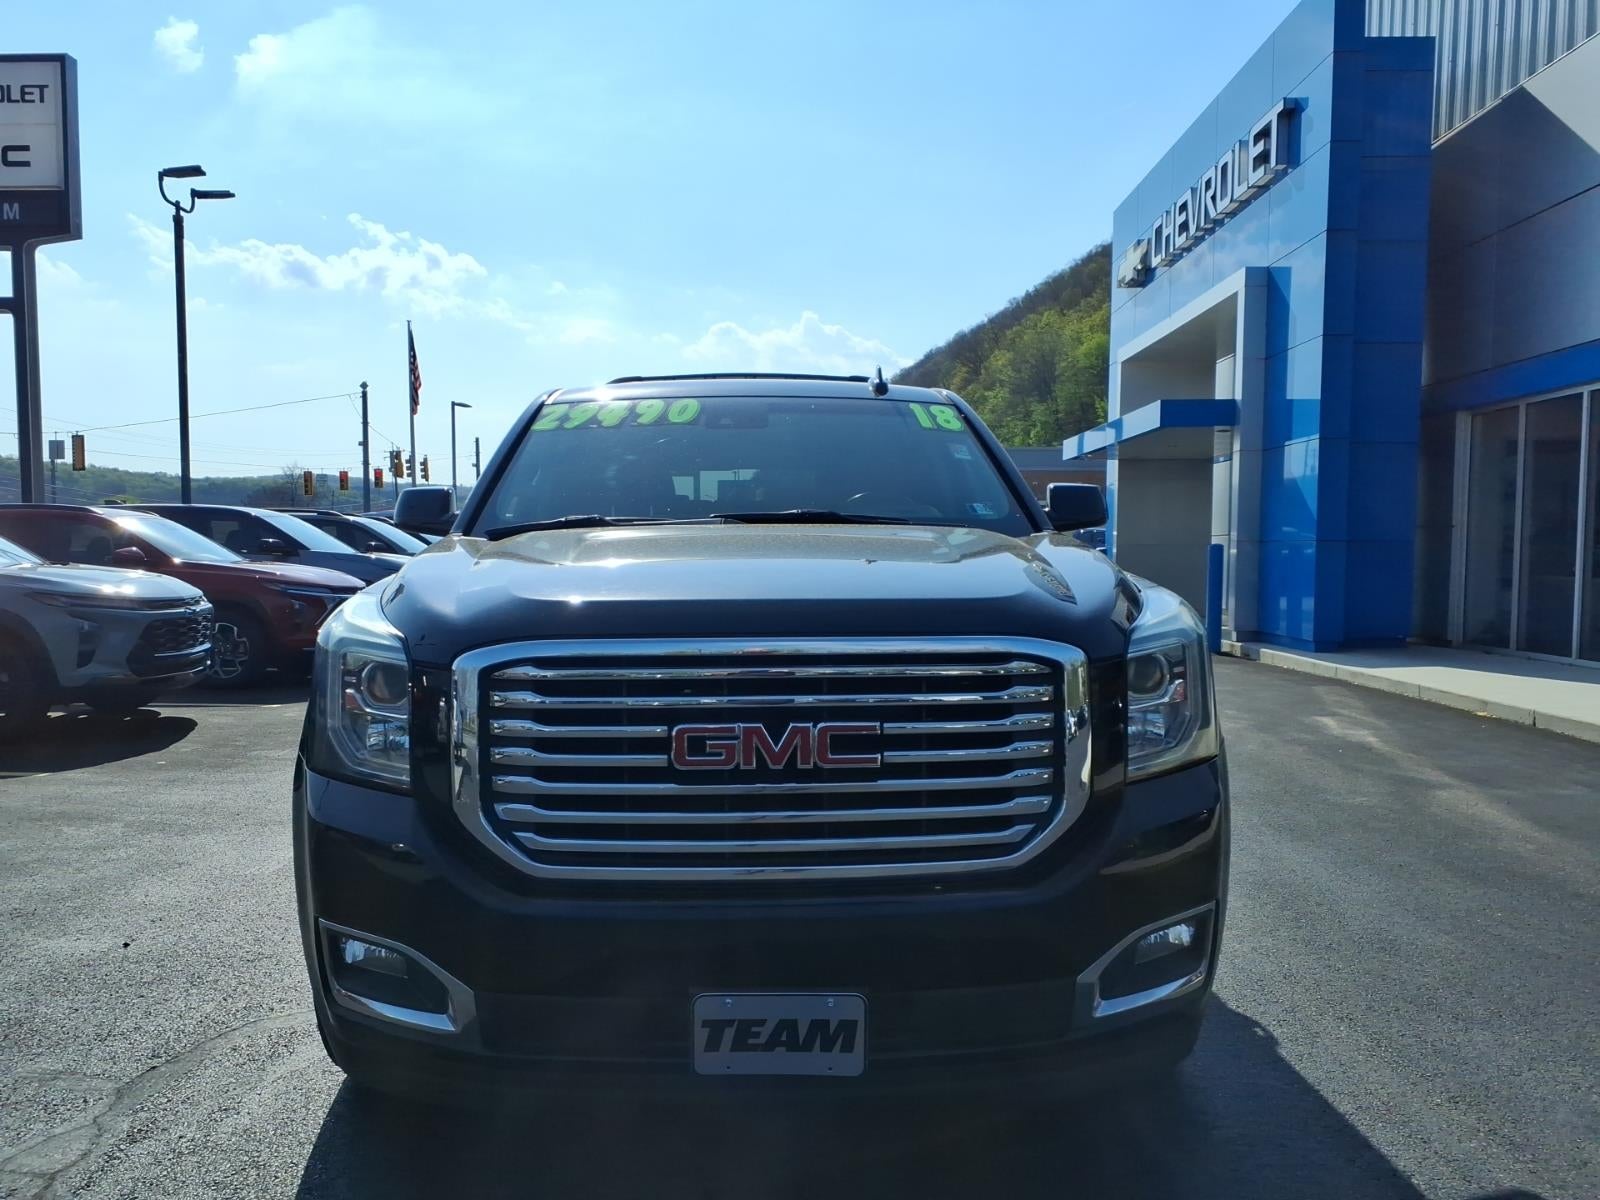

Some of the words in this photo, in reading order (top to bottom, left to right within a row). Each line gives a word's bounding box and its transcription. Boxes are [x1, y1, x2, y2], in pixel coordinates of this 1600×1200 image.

[1, 144, 31, 168] C
[1151, 97, 1296, 268] CHEVROLET
[3, 202, 20, 221] M
[531, 398, 700, 431] 29490
[909, 402, 964, 432] 18
[671, 721, 881, 770] GMC
[701, 1018, 859, 1054] TEAM
